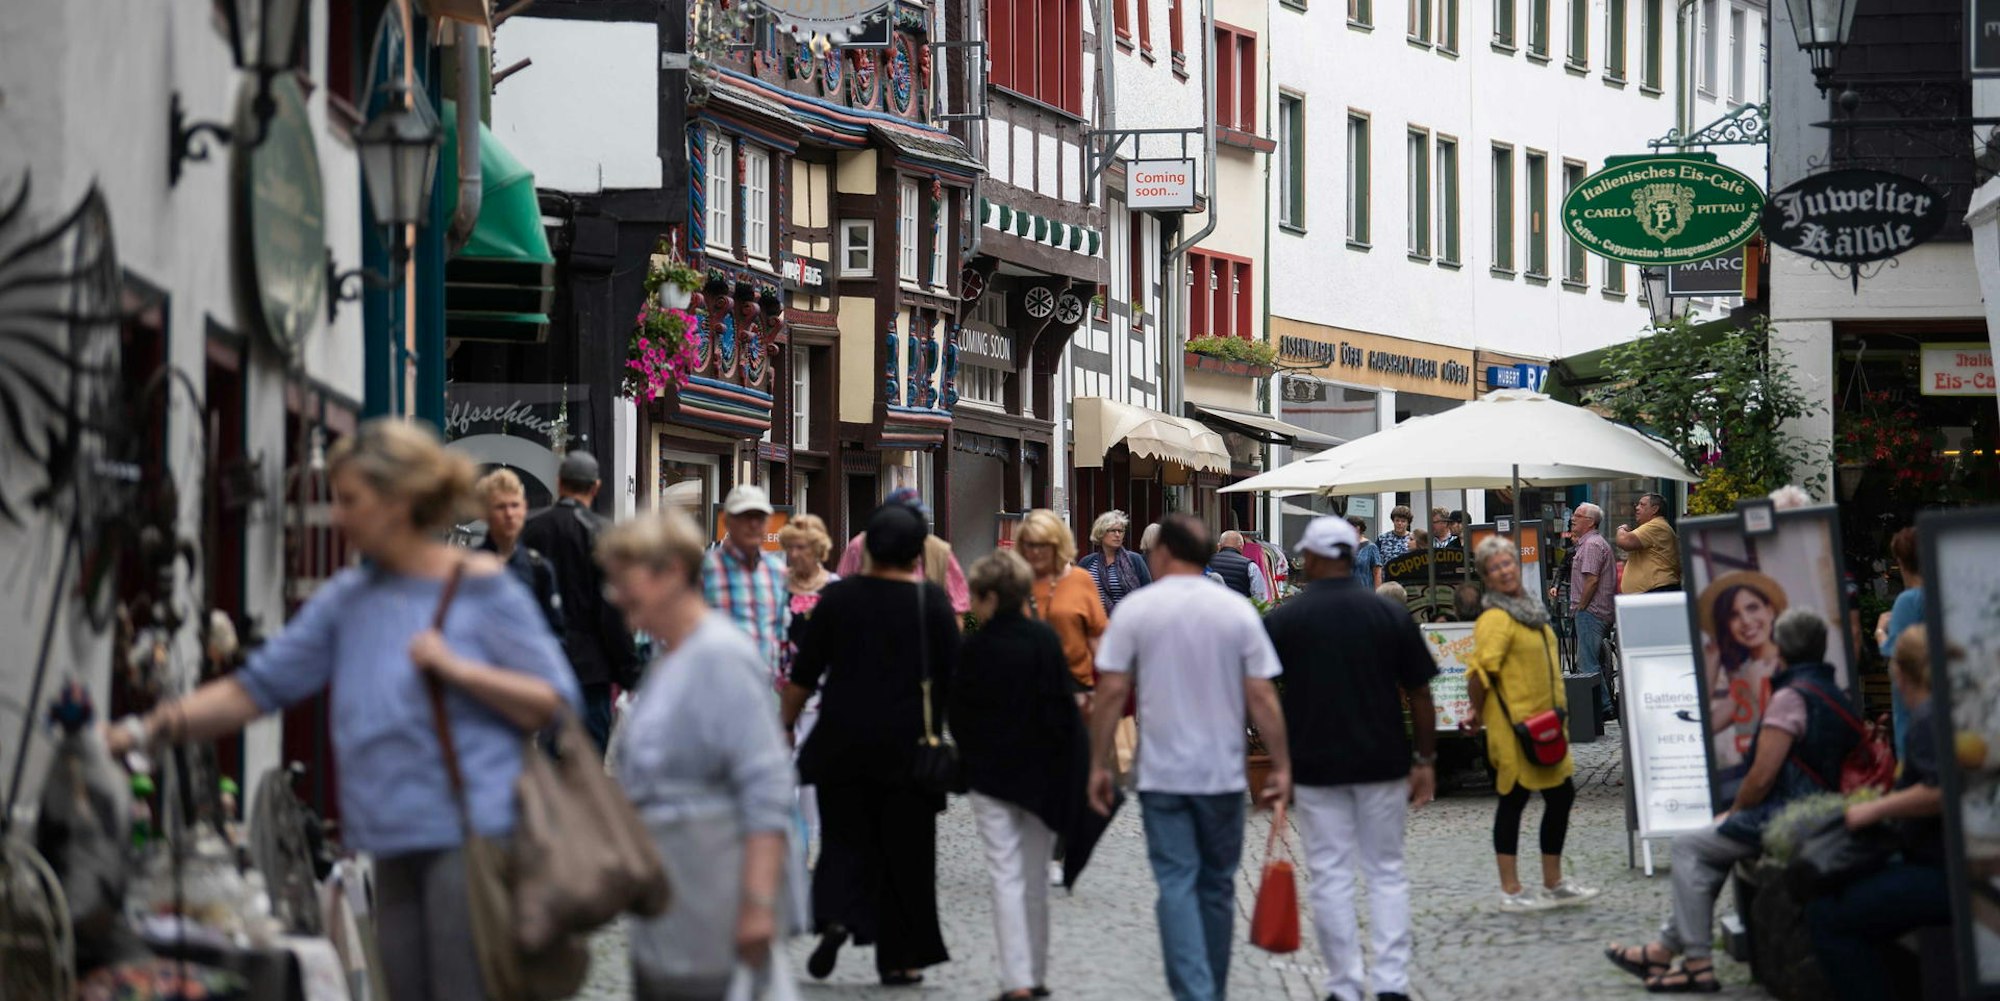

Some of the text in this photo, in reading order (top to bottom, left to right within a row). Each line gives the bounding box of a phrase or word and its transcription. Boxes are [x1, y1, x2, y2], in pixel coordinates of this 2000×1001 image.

[1135, 171, 1185, 185] Coming
[1135, 187, 1178, 197] soon...
[1581, 165, 1746, 201] Italienisches Eis-Café
[1584, 207, 1632, 219] CARLO
[1697, 202, 1746, 215] PITTAU
[1774, 182, 1932, 231] Juwelier
[1602, 239, 1660, 259] Cappuccino
[1663, 235, 1730, 257] Hausgemachte
[1728, 211, 1759, 241] Kuchen
[1791, 221, 1915, 256] Kälble
[958, 328, 1011, 361] COMING SOON
[1279, 335, 1336, 364] EISENWAREN
[1340, 341, 1364, 368] ÖFEN
[1388, 550, 1463, 577] Cappucino
[1657, 735, 1685, 745] HIER
